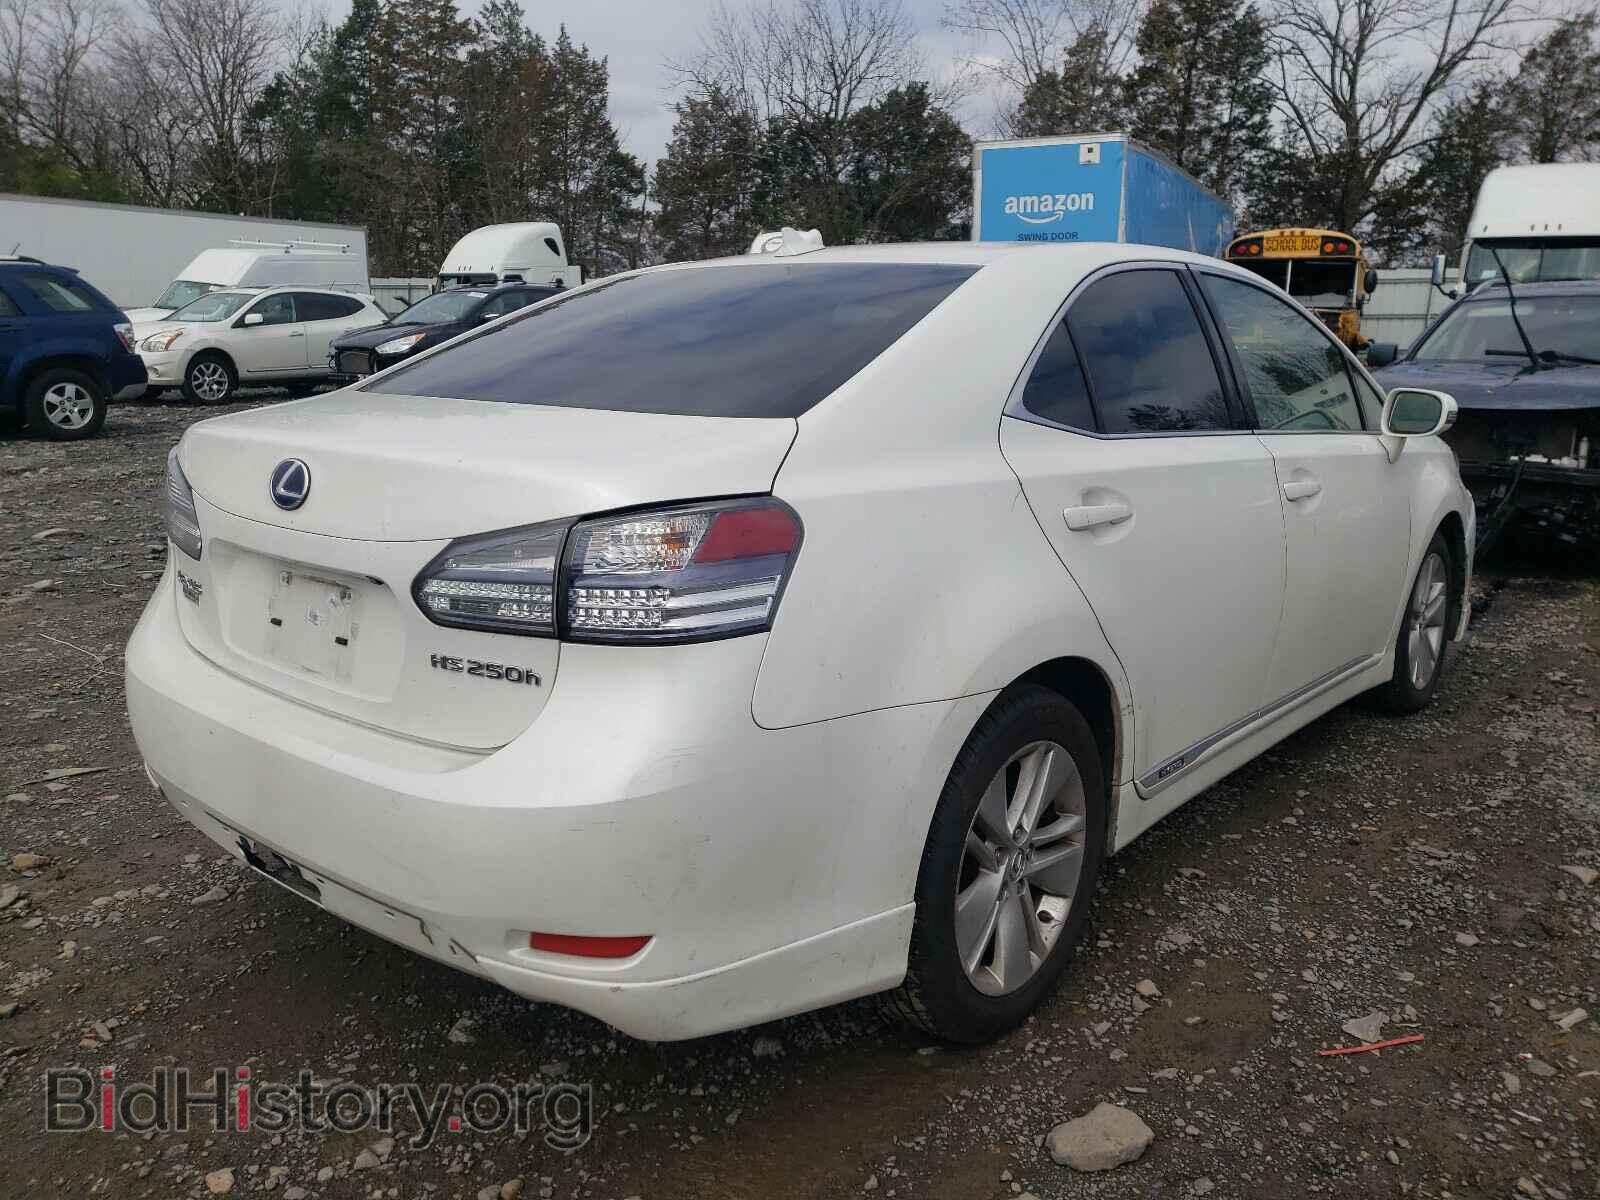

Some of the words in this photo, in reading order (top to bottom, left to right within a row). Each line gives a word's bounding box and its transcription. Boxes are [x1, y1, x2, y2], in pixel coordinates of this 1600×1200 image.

[1004, 192, 1094, 214] amazon
[1017, 232, 1048, 241] SWING
[1051, 232, 1079, 240] DOOR
[1264, 238, 1300, 251] SCHOOL
[1302, 237, 1319, 251] BUS
